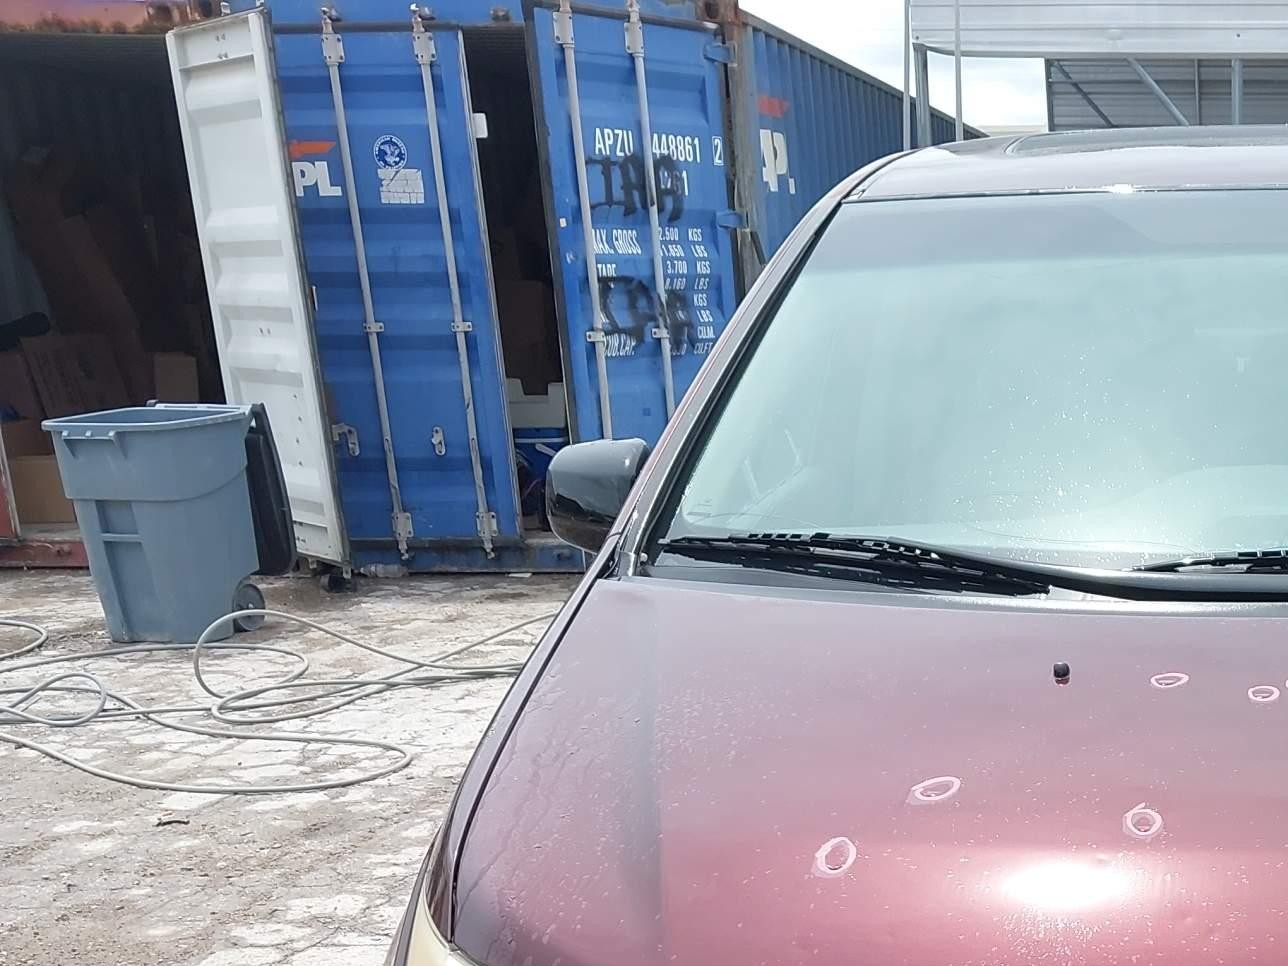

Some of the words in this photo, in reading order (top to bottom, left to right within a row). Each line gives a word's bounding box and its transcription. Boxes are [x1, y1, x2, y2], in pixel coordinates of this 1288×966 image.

[594, 127, 634, 156] APZU
[652, 133, 701, 163] 448861
[714, 138, 722, 163] 2
[613, 229, 642, 256] GROSS
[688, 228, 703, 241] KGS
[691, 245, 708, 258] LBS
[666, 260, 688, 274] 3.700
[696, 261, 711, 274] KGS
[694, 278, 709, 290] LBS
[693, 293, 708, 307] KGS
[696, 309, 713, 322] LBS
